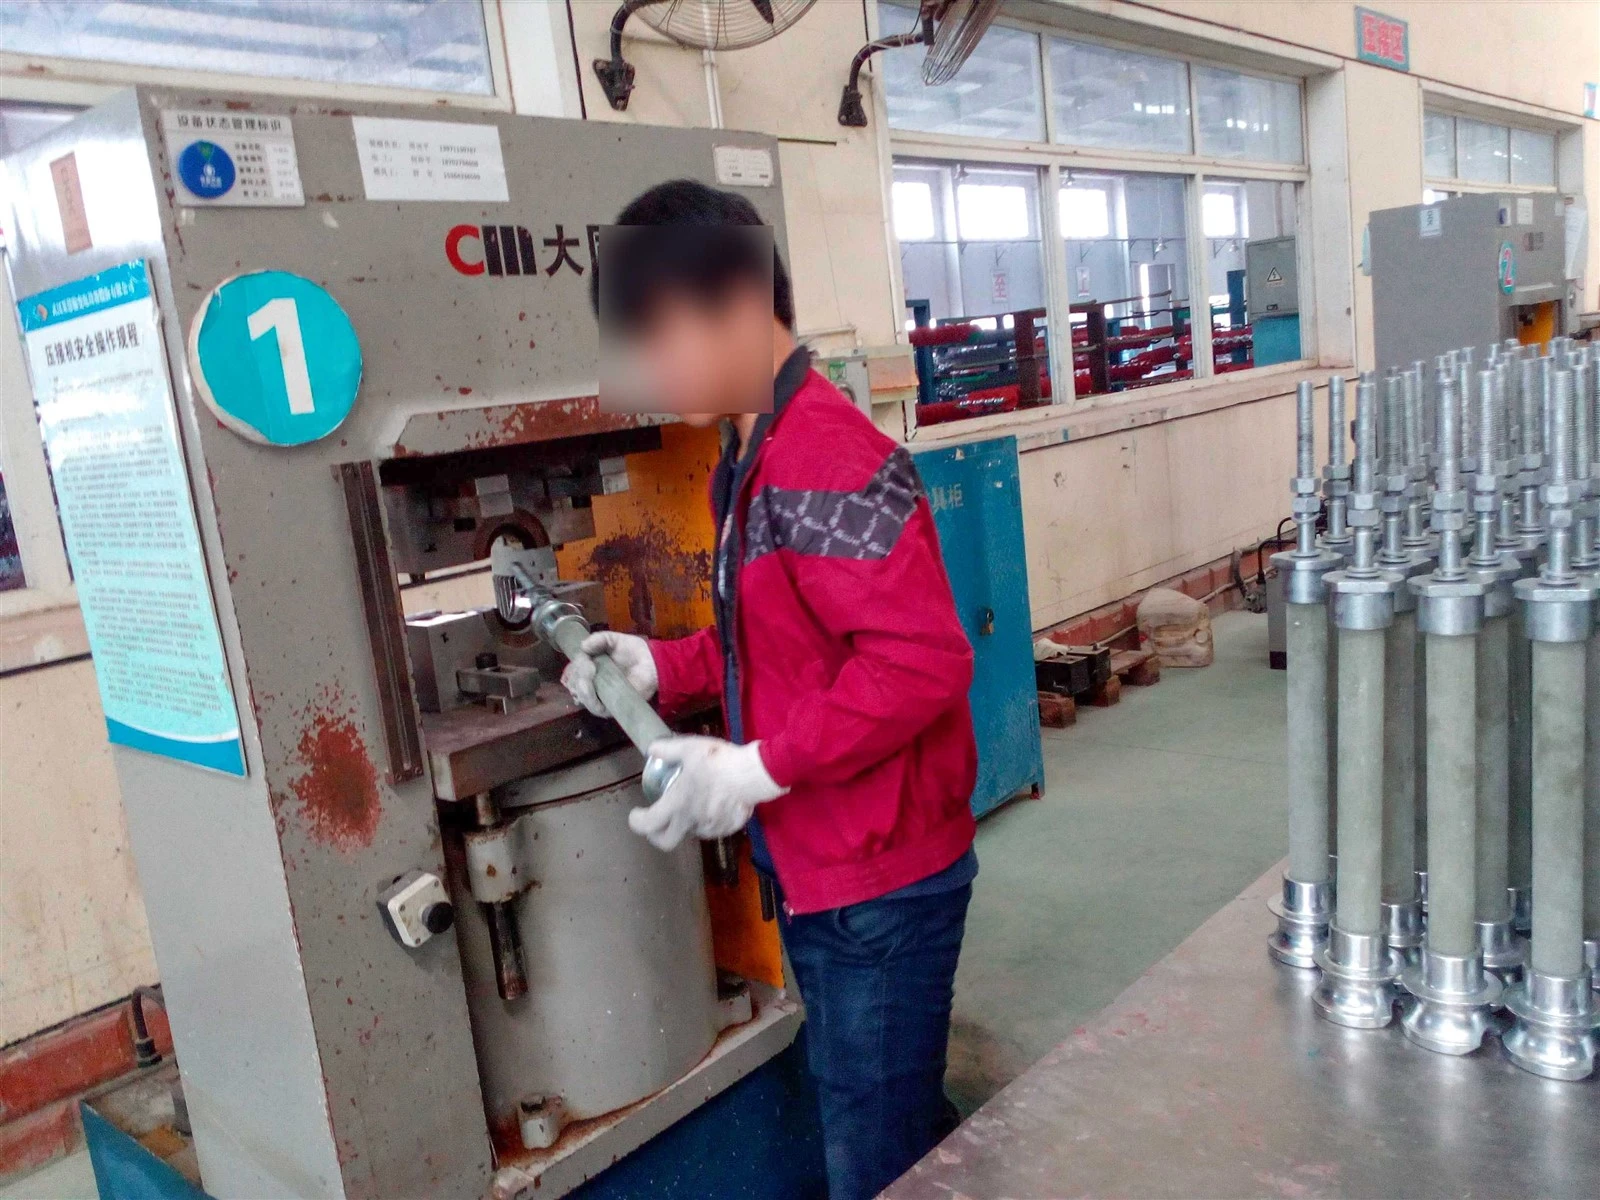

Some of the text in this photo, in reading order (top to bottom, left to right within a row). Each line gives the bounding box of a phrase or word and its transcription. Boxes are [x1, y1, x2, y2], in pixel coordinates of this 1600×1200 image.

[1503, 249, 1512, 287] 2
[45, 321, 140, 366] 压接机安全操作规程
[247, 297, 315, 415] 1
